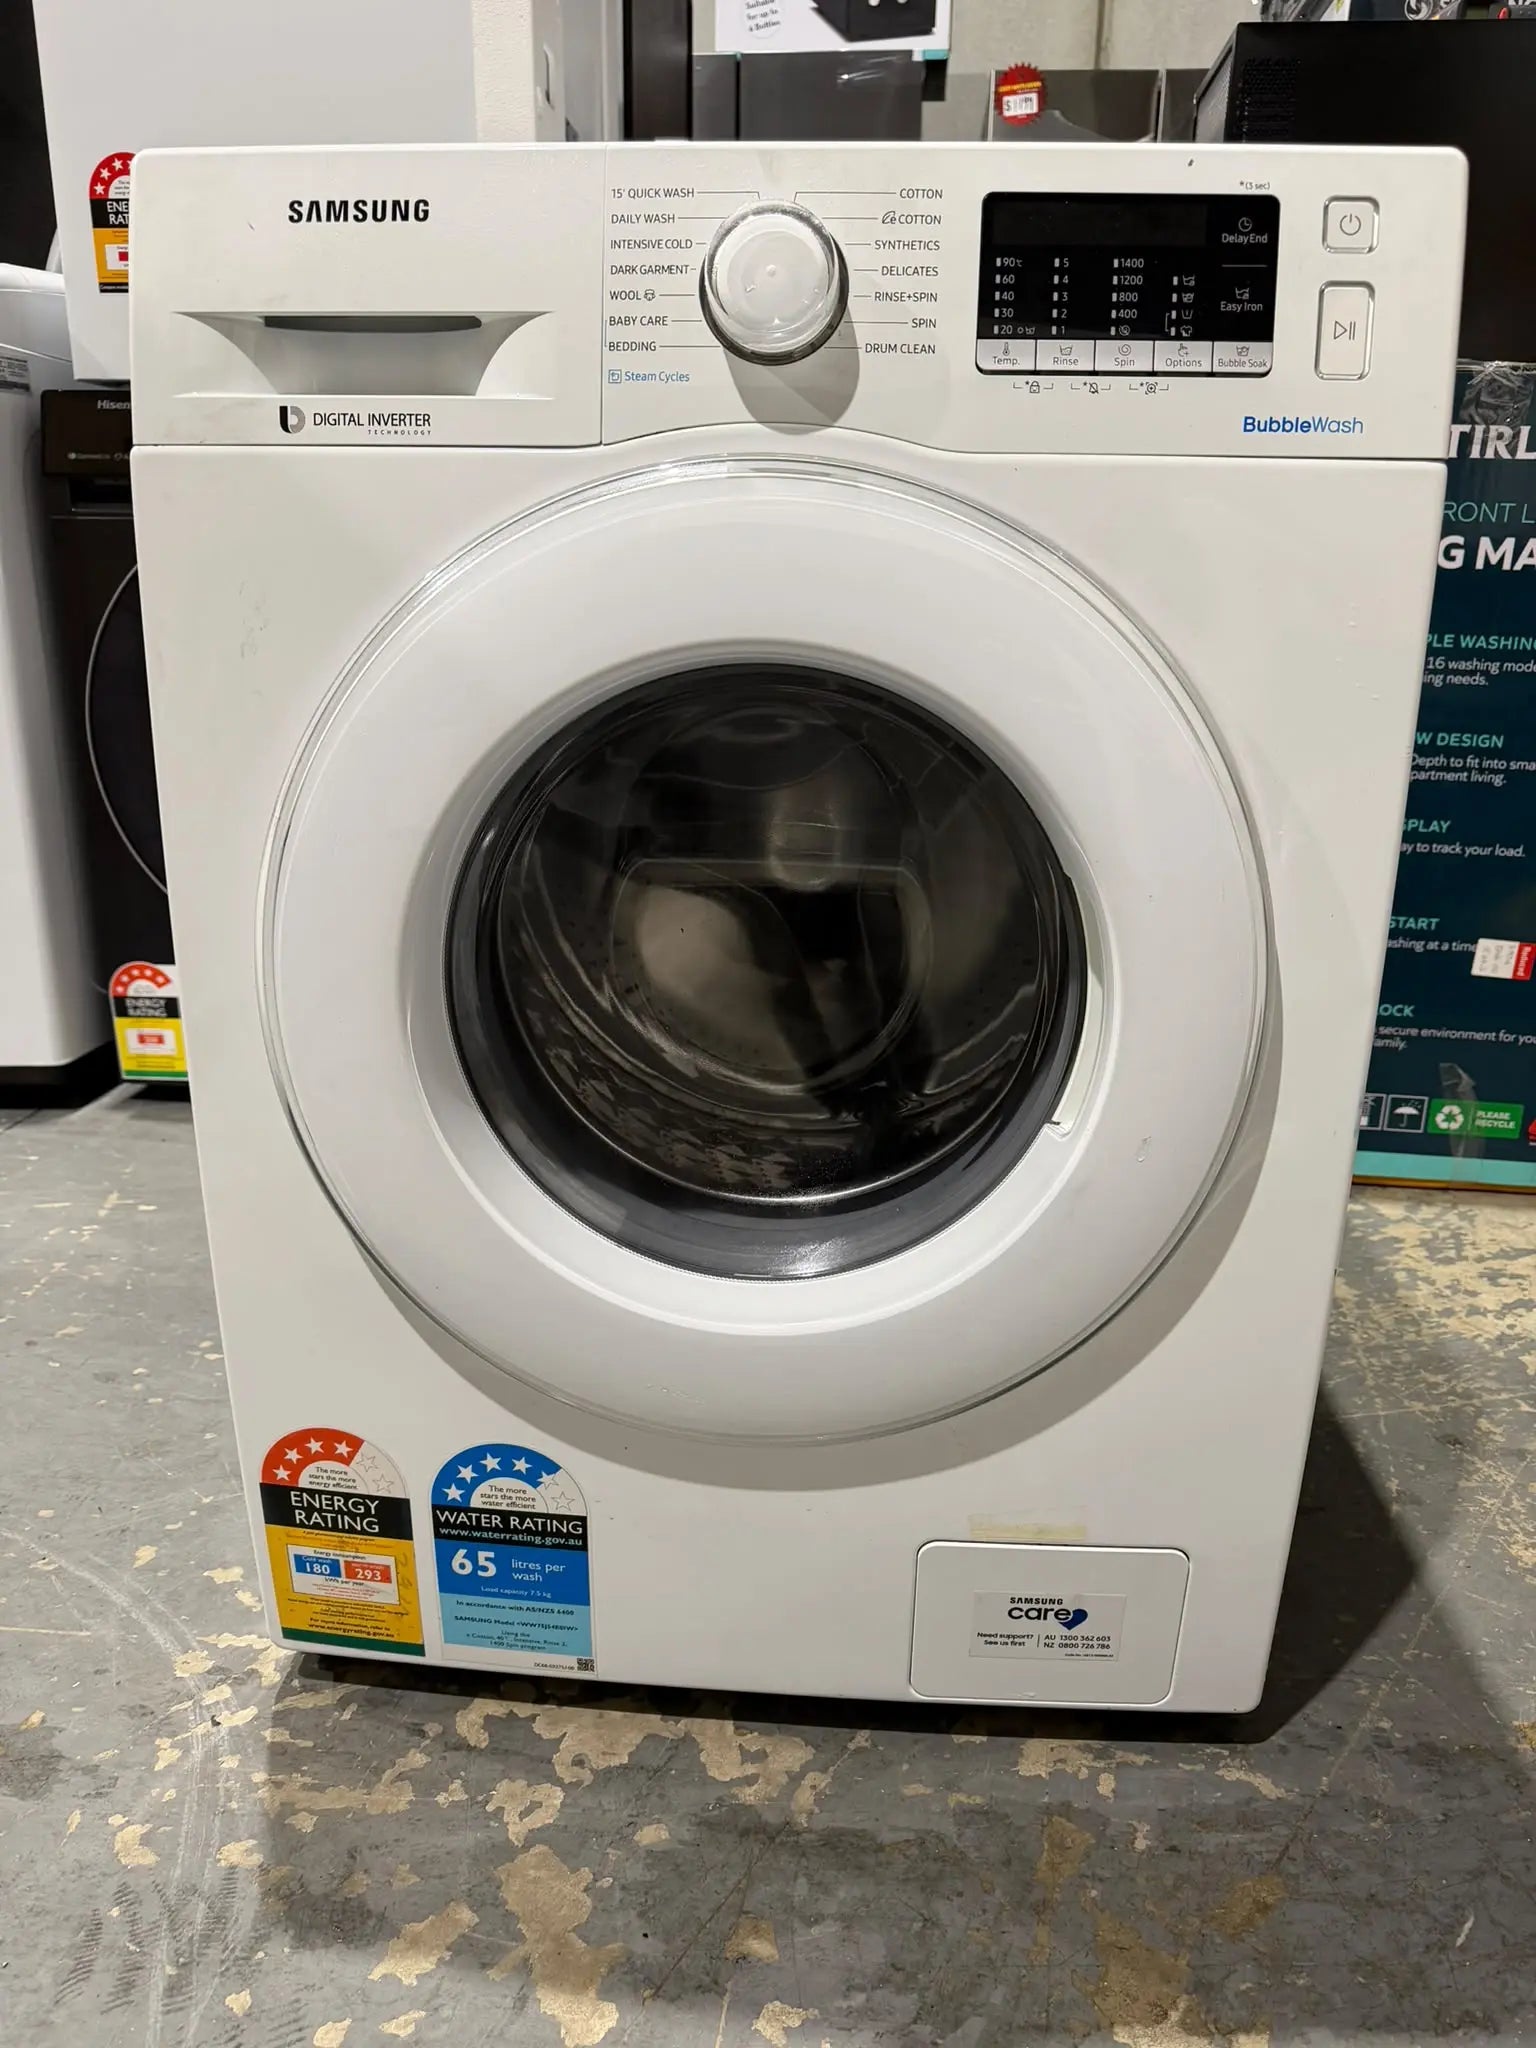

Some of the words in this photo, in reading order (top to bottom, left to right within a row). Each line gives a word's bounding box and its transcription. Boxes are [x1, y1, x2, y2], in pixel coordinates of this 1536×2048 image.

[1255, 182, 1270, 190] sec)
[628, 188, 661, 198] QUICK
[663, 188, 694, 198] WASH
[900, 188, 943, 199] COTTON
[288, 199, 430, 223] SAMSUNG
[611, 214, 641, 224] DAILY
[644, 214, 675, 224] WASH
[610, 239, 663, 249] INTENSIVE
[665, 239, 693, 249] COLD
[874, 240, 940, 251] SYNTHETICS
[1063, 258, 1069, 267] 5
[1120, 258, 1144, 268] 1400
[610, 265, 638, 275] DARK
[639, 264, 689, 275] GARMENT
[881, 265, 938, 277] DELICATES
[1002, 274, 1015, 284] 60
[1062, 275, 1069, 284] 4
[1120, 275, 1143, 285] 1200
[609, 290, 641, 300] WOOL
[874, 292, 938, 302] RINSE+SPIN
[1002, 291, 1014, 301] 40
[1062, 292, 1068, 301] 3
[1119, 292, 1138, 301] 800
[1221, 302, 1242, 312] Easy
[1244, 302, 1263, 311] Iron
[1001, 308, 1014, 317] 30
[1061, 309, 1067, 318] 2
[1118, 309, 1137, 318] 400
[609, 316, 637, 326] BABY
[640, 316, 668, 326] CARE
[911, 318, 937, 328] SPIN
[1000, 325, 1013, 334] 20
[608, 342, 656, 352] BEDDING
[865, 343, 897, 353] DRUM
[900, 344, 936, 354] CLEAN
[993, 356, 1020, 366] Temp.
[1053, 356, 1079, 366] Rinse
[1114, 358, 1135, 367] Spin
[1165, 358, 1202, 368] Options
[1218, 359, 1246, 367] Bubble
[1249, 359, 1267, 368] Soak
[624, 371, 656, 381] Steam
[658, 371, 690, 383] Cycles
[313, 412, 364, 426] DIGITAL
[367, 413, 431, 427] INVERTER
[1448, 424, 1536, 459] TIRL
[1437, 535, 1465, 569] G
[1460, 635, 1536, 650] WASHIN
[1427, 656, 1445, 669] 16
[1448, 658, 1500, 675] washing
[1446, 673, 1489, 685] needs.
[1436, 733, 1504, 748] DESIGN
[1449, 757, 1463, 767] to
[1466, 755, 1480, 768] fit
[1482, 757, 1507, 769] into
[1470, 770, 1507, 787] living.
[1416, 843, 1430, 853] to
[1431, 842, 1462, 854] track
[1464, 845, 1495, 858] your
[1494, 843, 1526, 857] load.
[1426, 940, 1439, 951] at
[1441, 942, 1449, 951] a
[1379, 1026, 1419, 1036] secure
[1421, 1027, 1496, 1041] environment
[1499, 1029, 1516, 1042] for
[1477, 1110, 1511, 1120] PLEASE
[1475, 1119, 1515, 1129] RECYCLE
[309, 1480, 330, 1488] energy
[488, 1485, 504, 1493] The
[506, 1487, 527, 1495] more
[290, 1491, 379, 1515] ENERGY
[515, 1495, 536, 1503] more
[505, 1502, 536, 1510] efficient
[295, 1509, 379, 1533] RATING
[436, 1509, 503, 1529] WATER
[510, 1516, 583, 1534] RATING
[439, 1527, 583, 1546] www.waterrating.gov.au
[306, 1562, 330, 1574] 180
[451, 1548, 497, 1578] 65
[512, 1559, 541, 1571] litres
[545, 1563, 566, 1574] per
[355, 1568, 382, 1581] 293
[512, 1572, 542, 1582] wash
[500, 1588, 528, 1597] capacity
[543, 1591, 552, 1599] kg
[1010, 1597, 1063, 1606] SAMSUNG
[465, 1601, 506, 1610] accordance
[507, 1604, 524, 1612] with
[525, 1606, 555, 1614] AS/NZS
[1008, 1606, 1072, 1621] care
[454, 1615, 492, 1624] SAMSUNG
